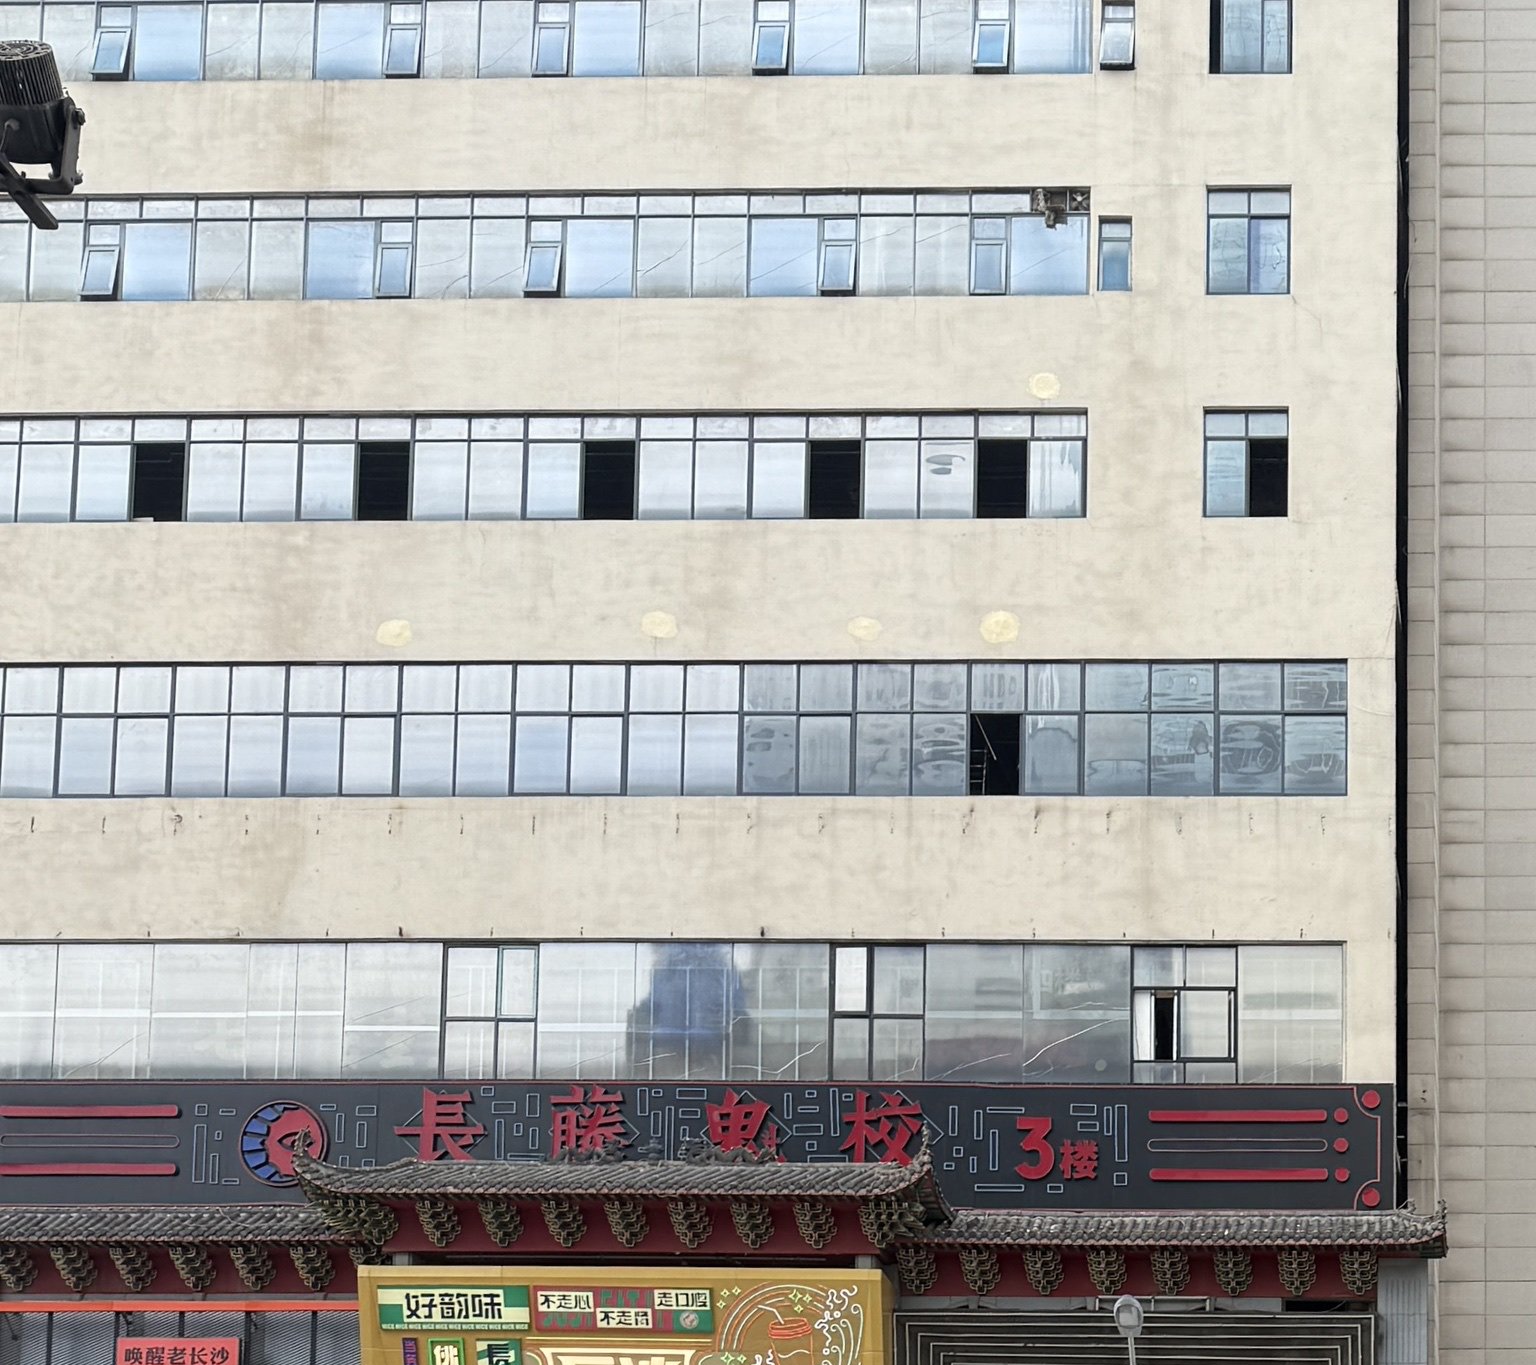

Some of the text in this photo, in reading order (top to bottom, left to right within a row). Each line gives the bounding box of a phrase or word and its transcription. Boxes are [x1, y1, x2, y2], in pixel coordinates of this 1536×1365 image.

[1015, 1117, 1098, 1181] 3楼
[405, 1293, 503, 1320] 好韵味
[124, 1347, 229, 1365] 唤醒老长沙
